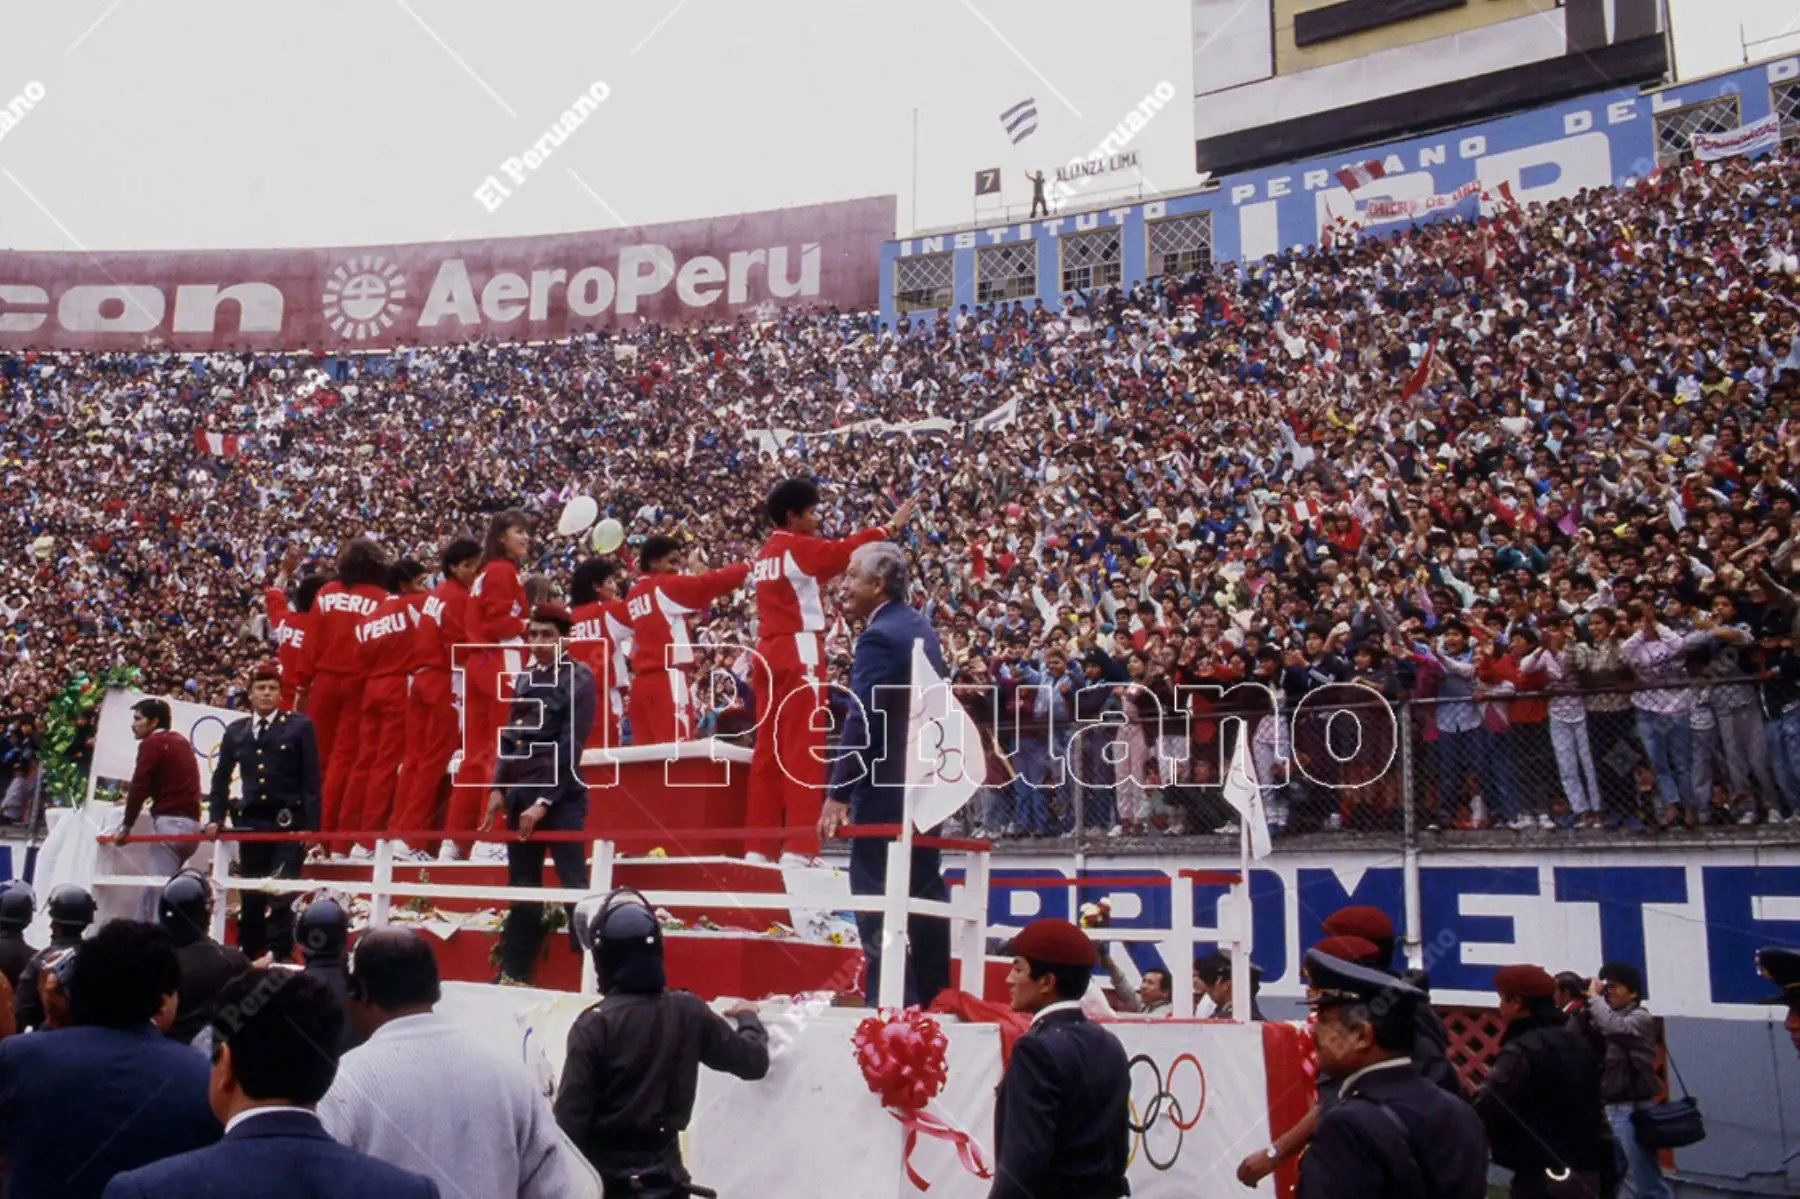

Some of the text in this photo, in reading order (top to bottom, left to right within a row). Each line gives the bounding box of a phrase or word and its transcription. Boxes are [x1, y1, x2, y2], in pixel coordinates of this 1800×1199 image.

[1109, 151, 1139, 172] LIMA
[900, 202, 1167, 257] INSTITUTO
[1231, 136, 1486, 204] PERANO
[1563, 92, 1683, 135] DEL
[983, 172, 995, 190] 7
[323, 592, 378, 616] PERU
[362, 612, 407, 642] PERU
